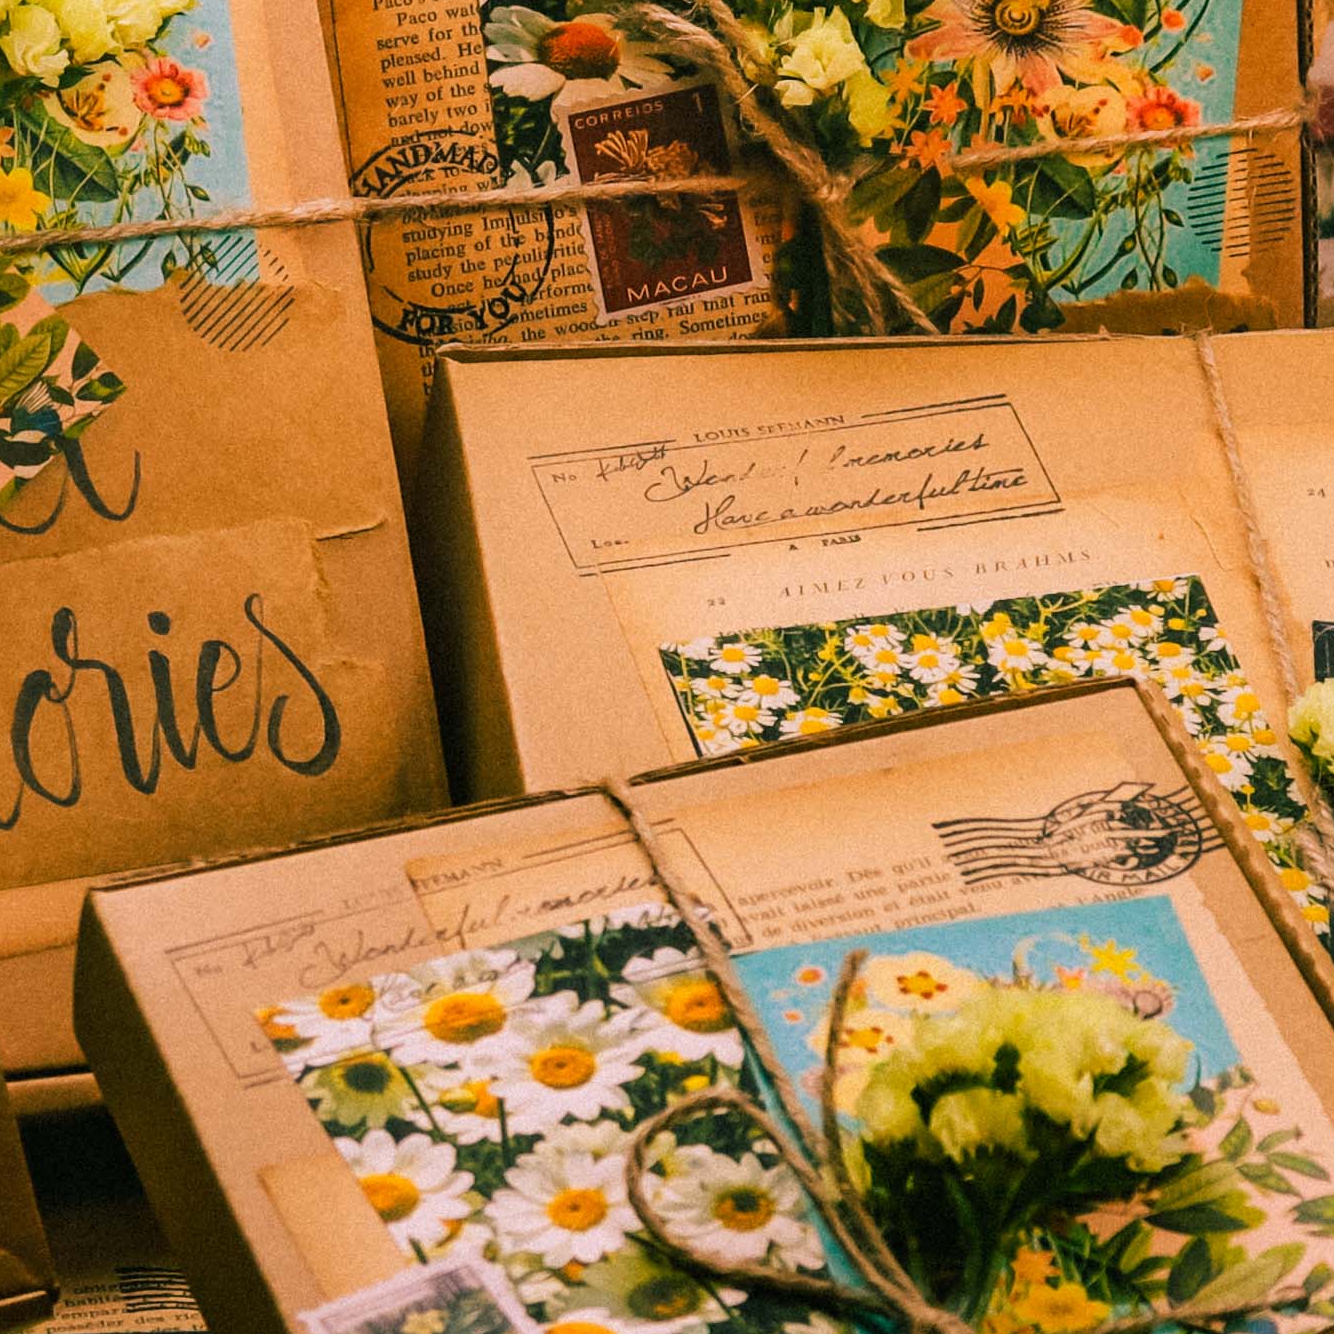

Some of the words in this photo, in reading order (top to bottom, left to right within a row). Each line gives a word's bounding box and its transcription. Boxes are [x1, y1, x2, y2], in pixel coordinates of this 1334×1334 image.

[377, 31, 419, 50] serve
[380, 47, 446, 73] pleased.
[424, 62, 480, 84] behind
[388, 109, 438, 127] barely
[574, 100, 665, 130] CORREIOS
[403, 222, 473, 243] studying
[406, 242, 466, 265] placing
[407, 264, 453, 282] study
[431, 282, 474, 297] Once
[627, 267, 728, 303] MACAU
[693, 427, 751, 443] LOUIS
[693, 494, 769, 535] Have
[780, 578, 866, 598] AIMEZ
[882, 567, 955, 585] VOUS
